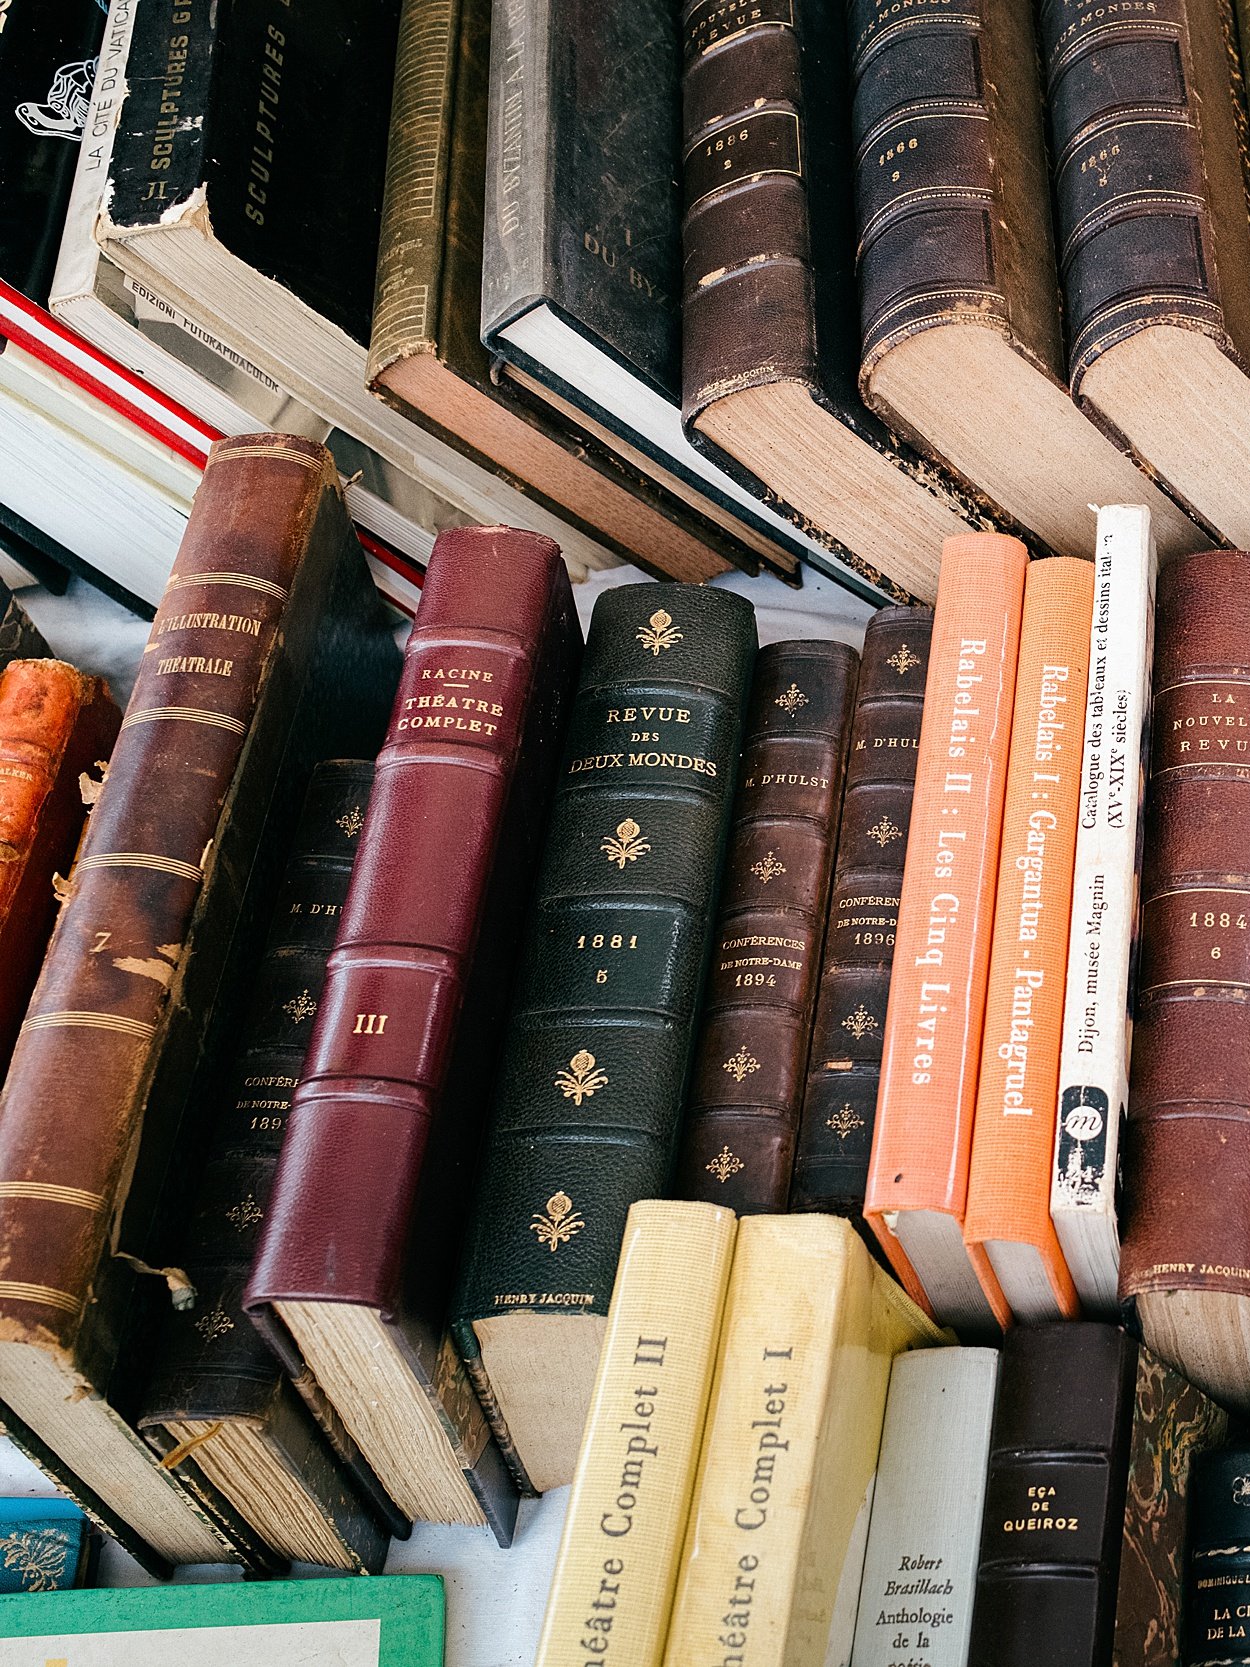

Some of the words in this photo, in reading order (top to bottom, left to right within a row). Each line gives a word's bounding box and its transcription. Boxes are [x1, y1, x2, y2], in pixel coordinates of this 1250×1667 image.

[1080, 2, 1157, 26] MONDES
[697, 9, 761, 49] REVUE
[507, 30, 526, 62] LA
[102, 67, 118, 92] DU
[151, 35, 189, 170] SCULPTURES
[92, 100, 113, 139] CITÉ
[245, 24, 286, 226] SCULPTURES
[706, 130, 748, 156] 1886
[879, 138, 918, 166] 1866
[86, 146, 102, 171] LA
[1081, 145, 1120, 174] 1866
[502, 200, 520, 237] DU
[131, 281, 176, 320] EDIZIONI
[1095, 582, 1111, 633] dessins
[158, 612, 261, 637] L'ILLUSTRATION
[421, 669, 494, 683] RACINE
[1090, 656, 1107, 718] tableaux
[404, 694, 504, 717] THÉATRE
[948, 638, 987, 758] Rabelais
[1212, 694, 1235, 704] LA
[606, 707, 692, 724] REVUE
[1035, 664, 1069, 761] Rabelais
[397, 717, 498, 736] COMPLET
[631, 732, 660, 743] DES
[1088, 723, 1102, 748] des
[568, 753, 622, 774] DEUX
[628, 752, 718, 777] MONDES
[762, 773, 829, 789] D'HULST
[943, 773, 974, 794] II
[1033, 772, 1061, 783] I
[1082, 753, 1104, 829] Catalogue
[935, 830, 966, 879] Les
[1015, 810, 1058, 942] Gargantua
[1086, 874, 1109, 935] Magnin
[836, 919, 850, 929] DE
[915, 893, 960, 967] Cinq
[1189, 912, 1248, 930] 1884
[576, 935, 638, 949] 1881
[722, 936, 806, 951] CONFÉRENCES
[854, 932, 895, 946] 1896
[720, 961, 734, 971] DE
[735, 957, 803, 970] NOTRE-DAME
[1211, 947, 1221, 959] 6
[596, 969, 608, 984] 5
[735, 974, 777, 987] 1894
[1085, 943, 1101, 997] musée
[353, 1014, 389, 1035] III
[912, 982, 951, 1085] Livres
[1078, 1000, 1100, 1054] Dijon,
[998, 967, 1045, 1117] Pantagruel
[250, 1117, 289, 1131] 189
[1152, 1263, 1195, 1274] HENRY
[1200, 1263, 1250, 1278] JACQUIN
[494, 1293, 535, 1305] HENRY
[540, 1293, 595, 1305] JACQUIN
[601, 1385, 659, 1538] Complet
[633, 1336, 668, 1367] II
[735, 1382, 790, 1532] Complet
[763, 1346, 793, 1361] I
[1027, 1486, 1056, 1499] EÇA
[1031, 1502, 1049, 1512] DE
[1003, 1518, 1079, 1532] QUEIROZ
[898, 1554, 943, 1571] Robert
[884, 1581, 953, 1597] Brasillach
[875, 1608, 954, 1628] Anthologie
[1214, 1608, 1231, 1621] LA
[892, 1633, 909, 1649] de
[916, 1631, 930, 1649] la
[1207, 1628, 1224, 1640] DE
[1228, 1626, 1246, 1638] LA
